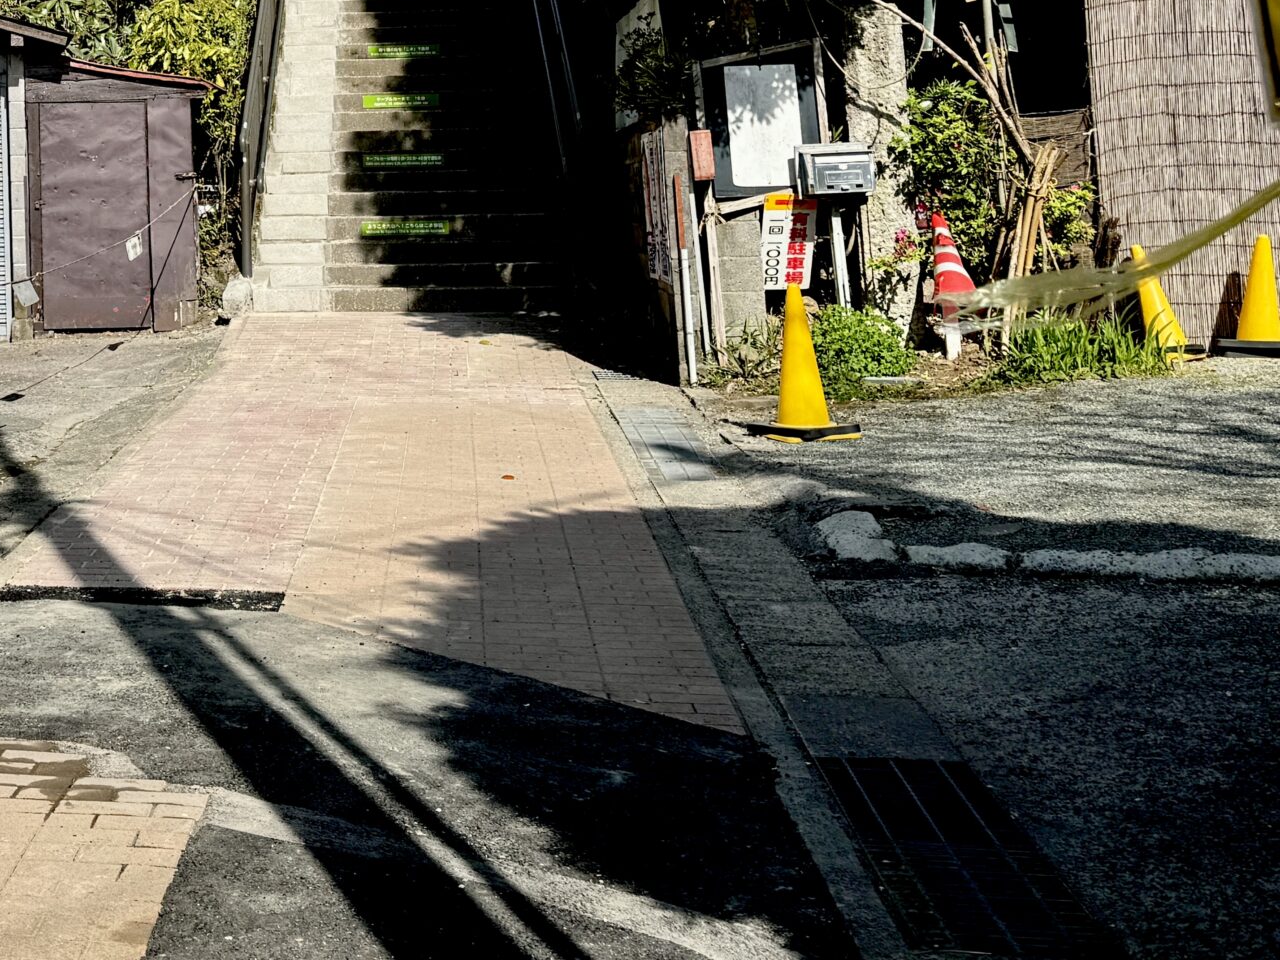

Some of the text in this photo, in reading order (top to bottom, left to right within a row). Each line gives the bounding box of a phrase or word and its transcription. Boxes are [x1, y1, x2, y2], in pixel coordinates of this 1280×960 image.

[785, 212, 810, 284] 有料駐車場
